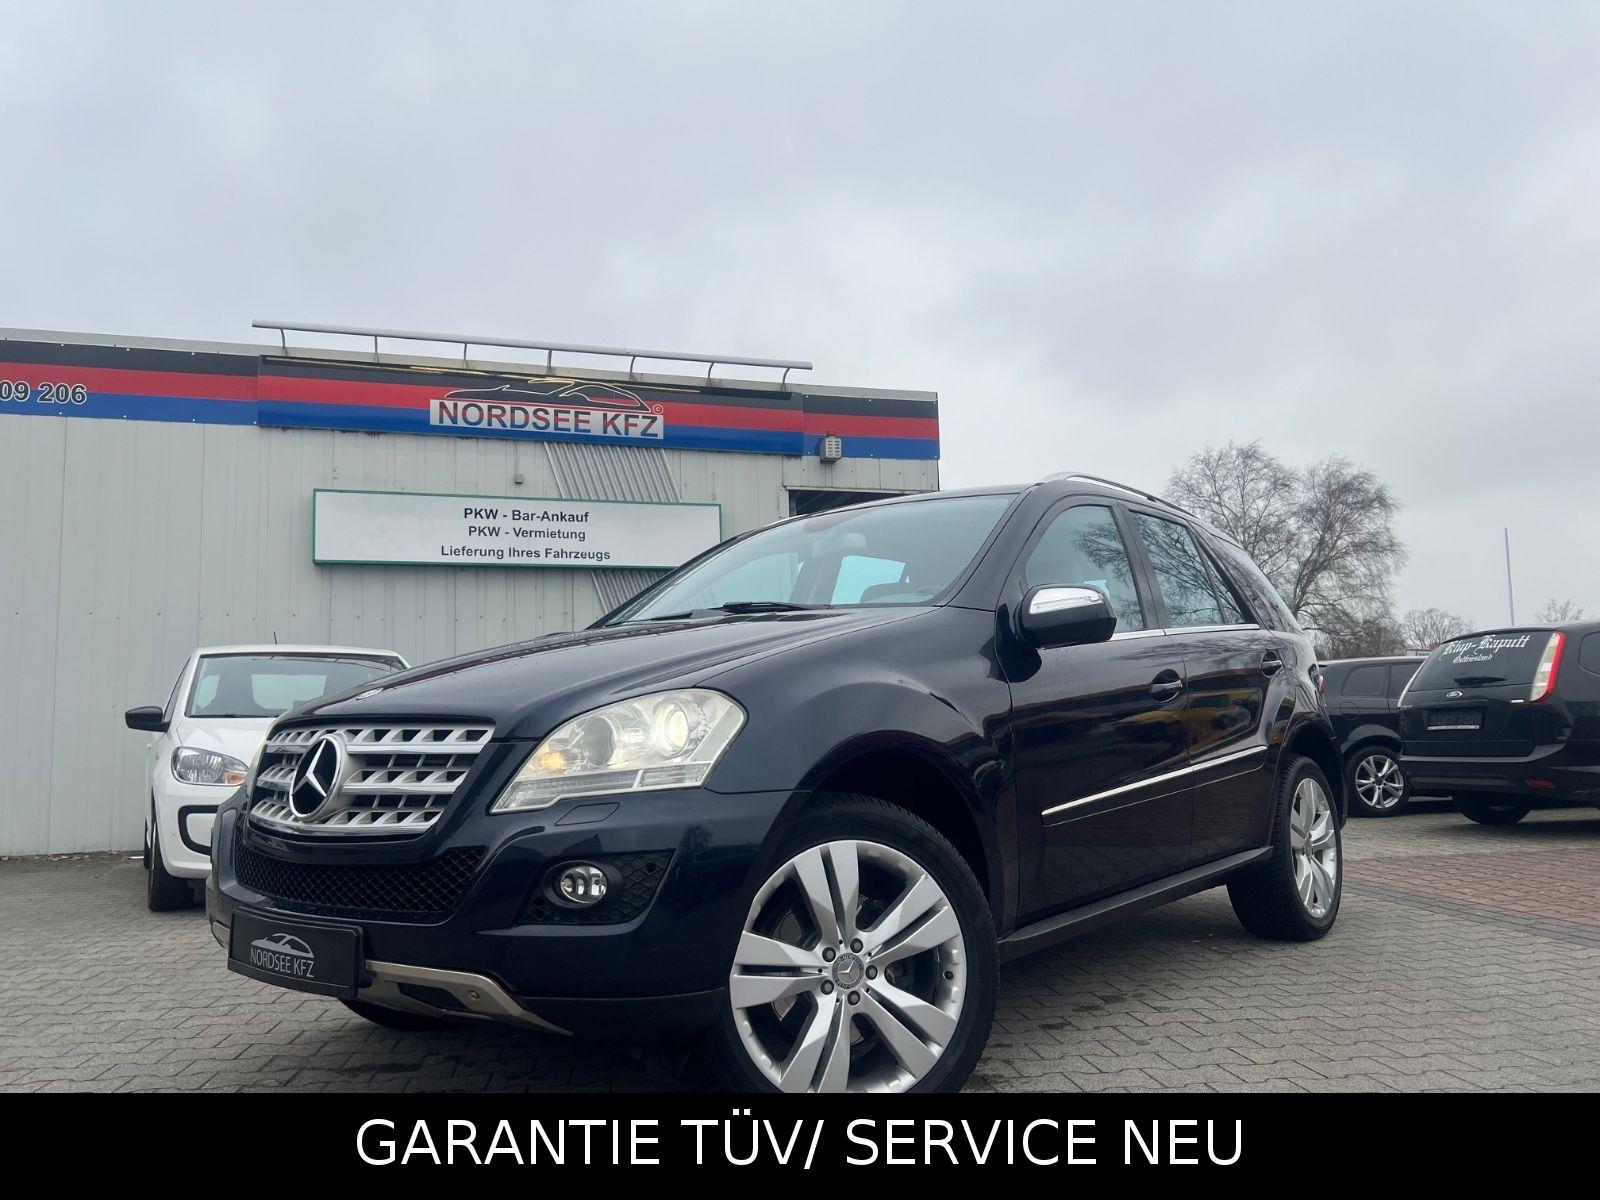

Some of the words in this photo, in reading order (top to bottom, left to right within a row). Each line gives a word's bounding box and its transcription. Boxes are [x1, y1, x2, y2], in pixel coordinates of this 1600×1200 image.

[0, 380, 30, 402] 09
[37, 382, 87, 405] 206
[438, 401, 591, 433] NORDSEE
[602, 412, 659, 438] KFZ
[464, 507, 498, 520] PKW
[512, 510, 589, 523] Bar-Ankauf
[468, 526, 501, 537] PKW
[513, 527, 586, 541] Vermietung
[441, 545, 504, 559] Lieferung
[508, 547, 541, 558] Ihres
[545, 548, 611, 561] Fahrzeugs
[250, 947, 291, 973] NORDSEE
[293, 957, 315, 978] KFZ
